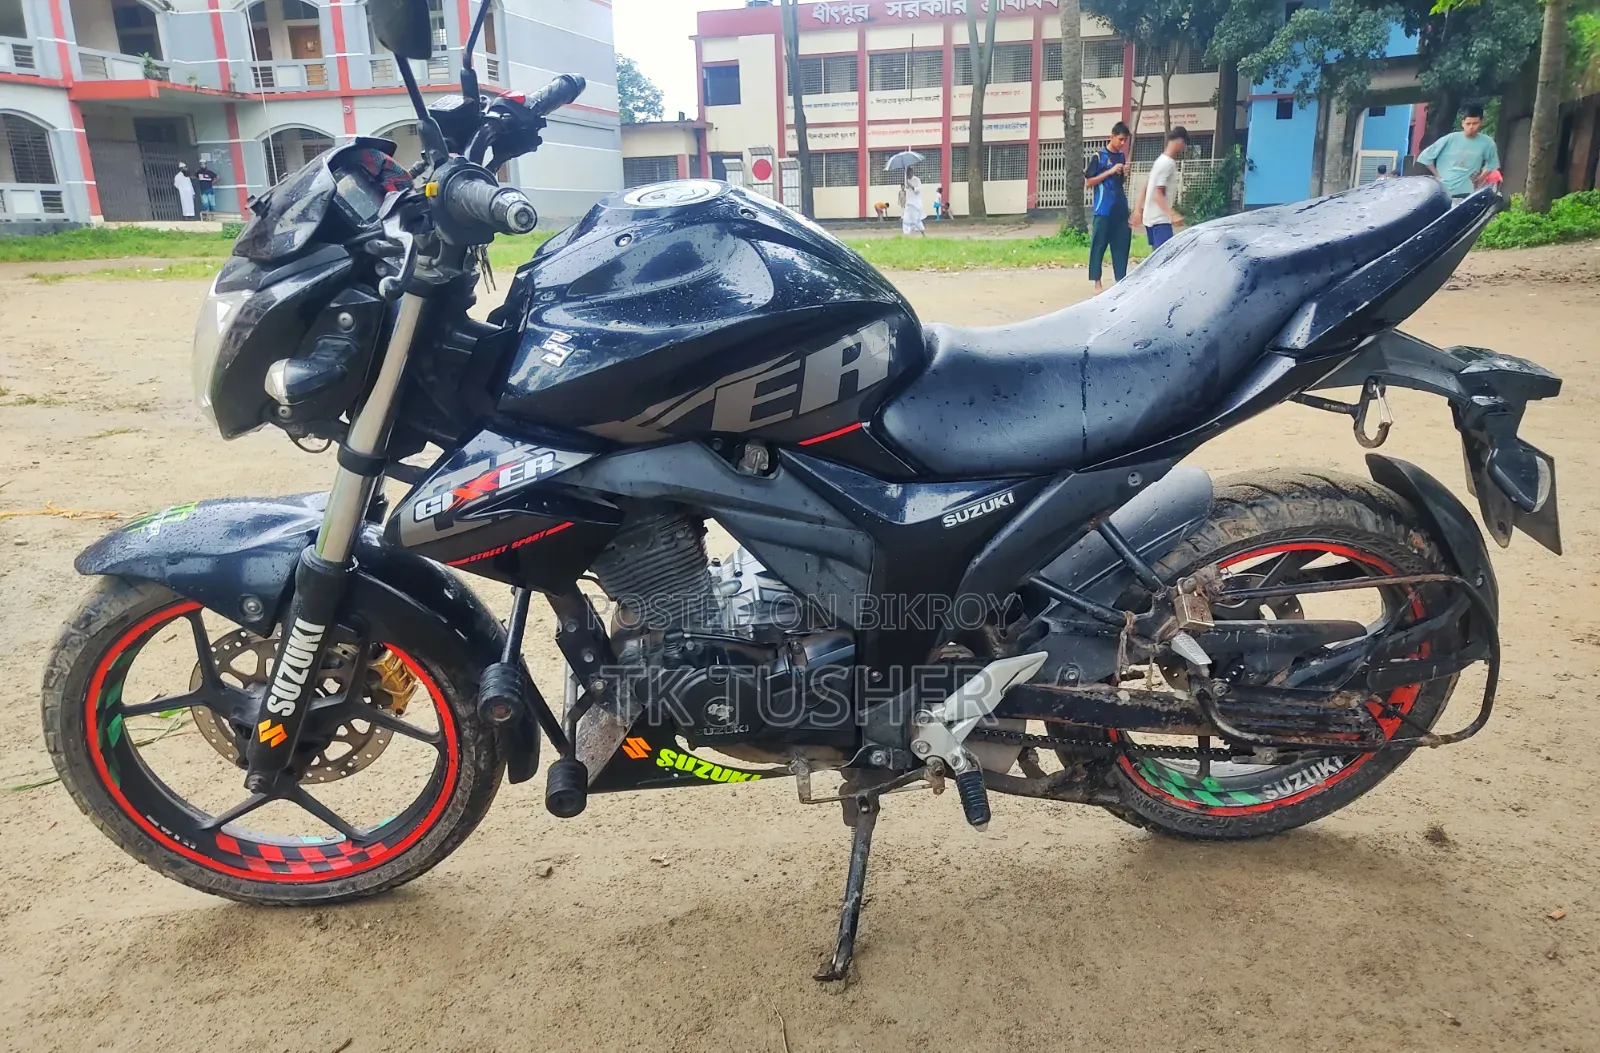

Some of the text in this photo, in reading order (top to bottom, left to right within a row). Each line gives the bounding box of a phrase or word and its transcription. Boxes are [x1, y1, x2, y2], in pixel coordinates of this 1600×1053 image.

[941, 491, 1015, 529] SUZUKI
[468, 530, 548, 562] STREET SPORT
[267, 617, 326, 717] SUZUKI
[1261, 755, 1344, 800] SUZUKI
